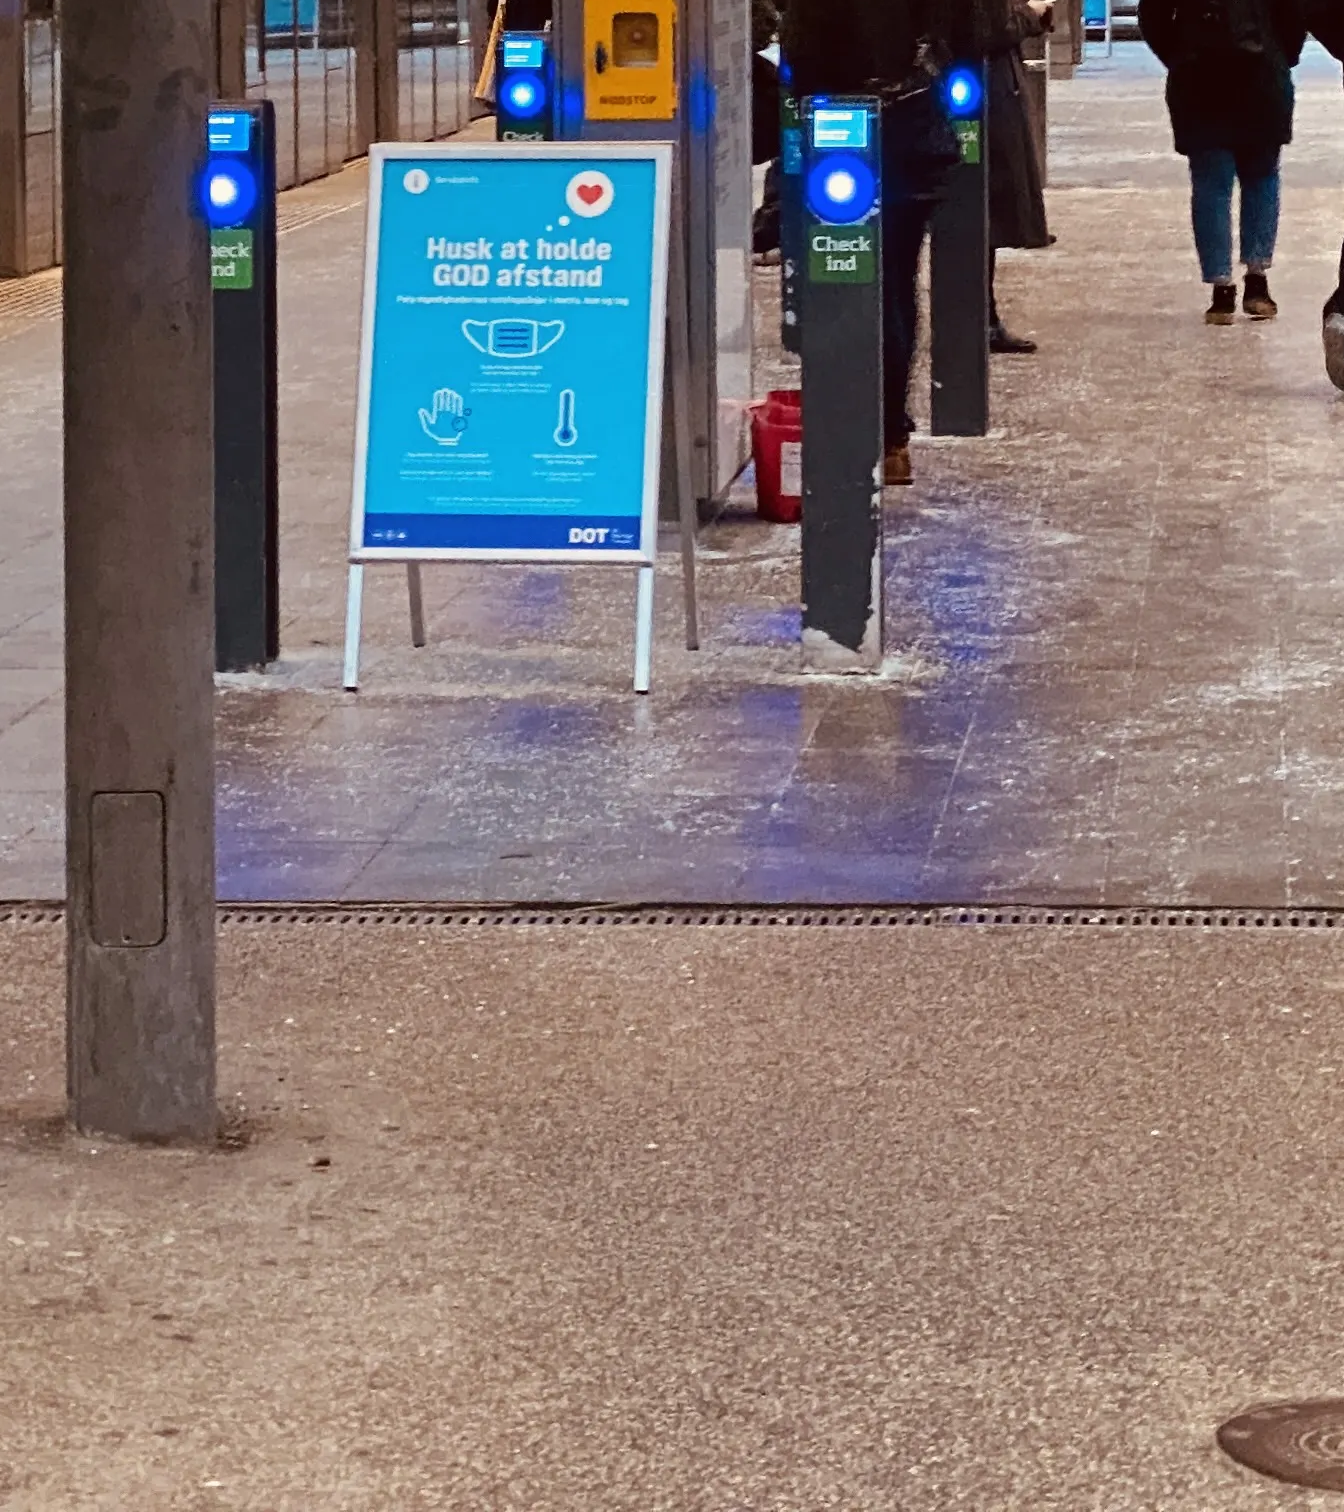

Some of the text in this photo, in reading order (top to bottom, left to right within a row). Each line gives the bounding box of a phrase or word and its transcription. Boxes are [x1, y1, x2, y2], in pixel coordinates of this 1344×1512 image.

[211, 242, 252, 258] eck
[426, 237, 612, 261] Husk at holde
[812, 235, 872, 252] Check
[211, 262, 236, 277] nd
[825, 255, 858, 272] ind
[433, 263, 603, 287] GOD afstand
[568, 527, 610, 544] DOT
